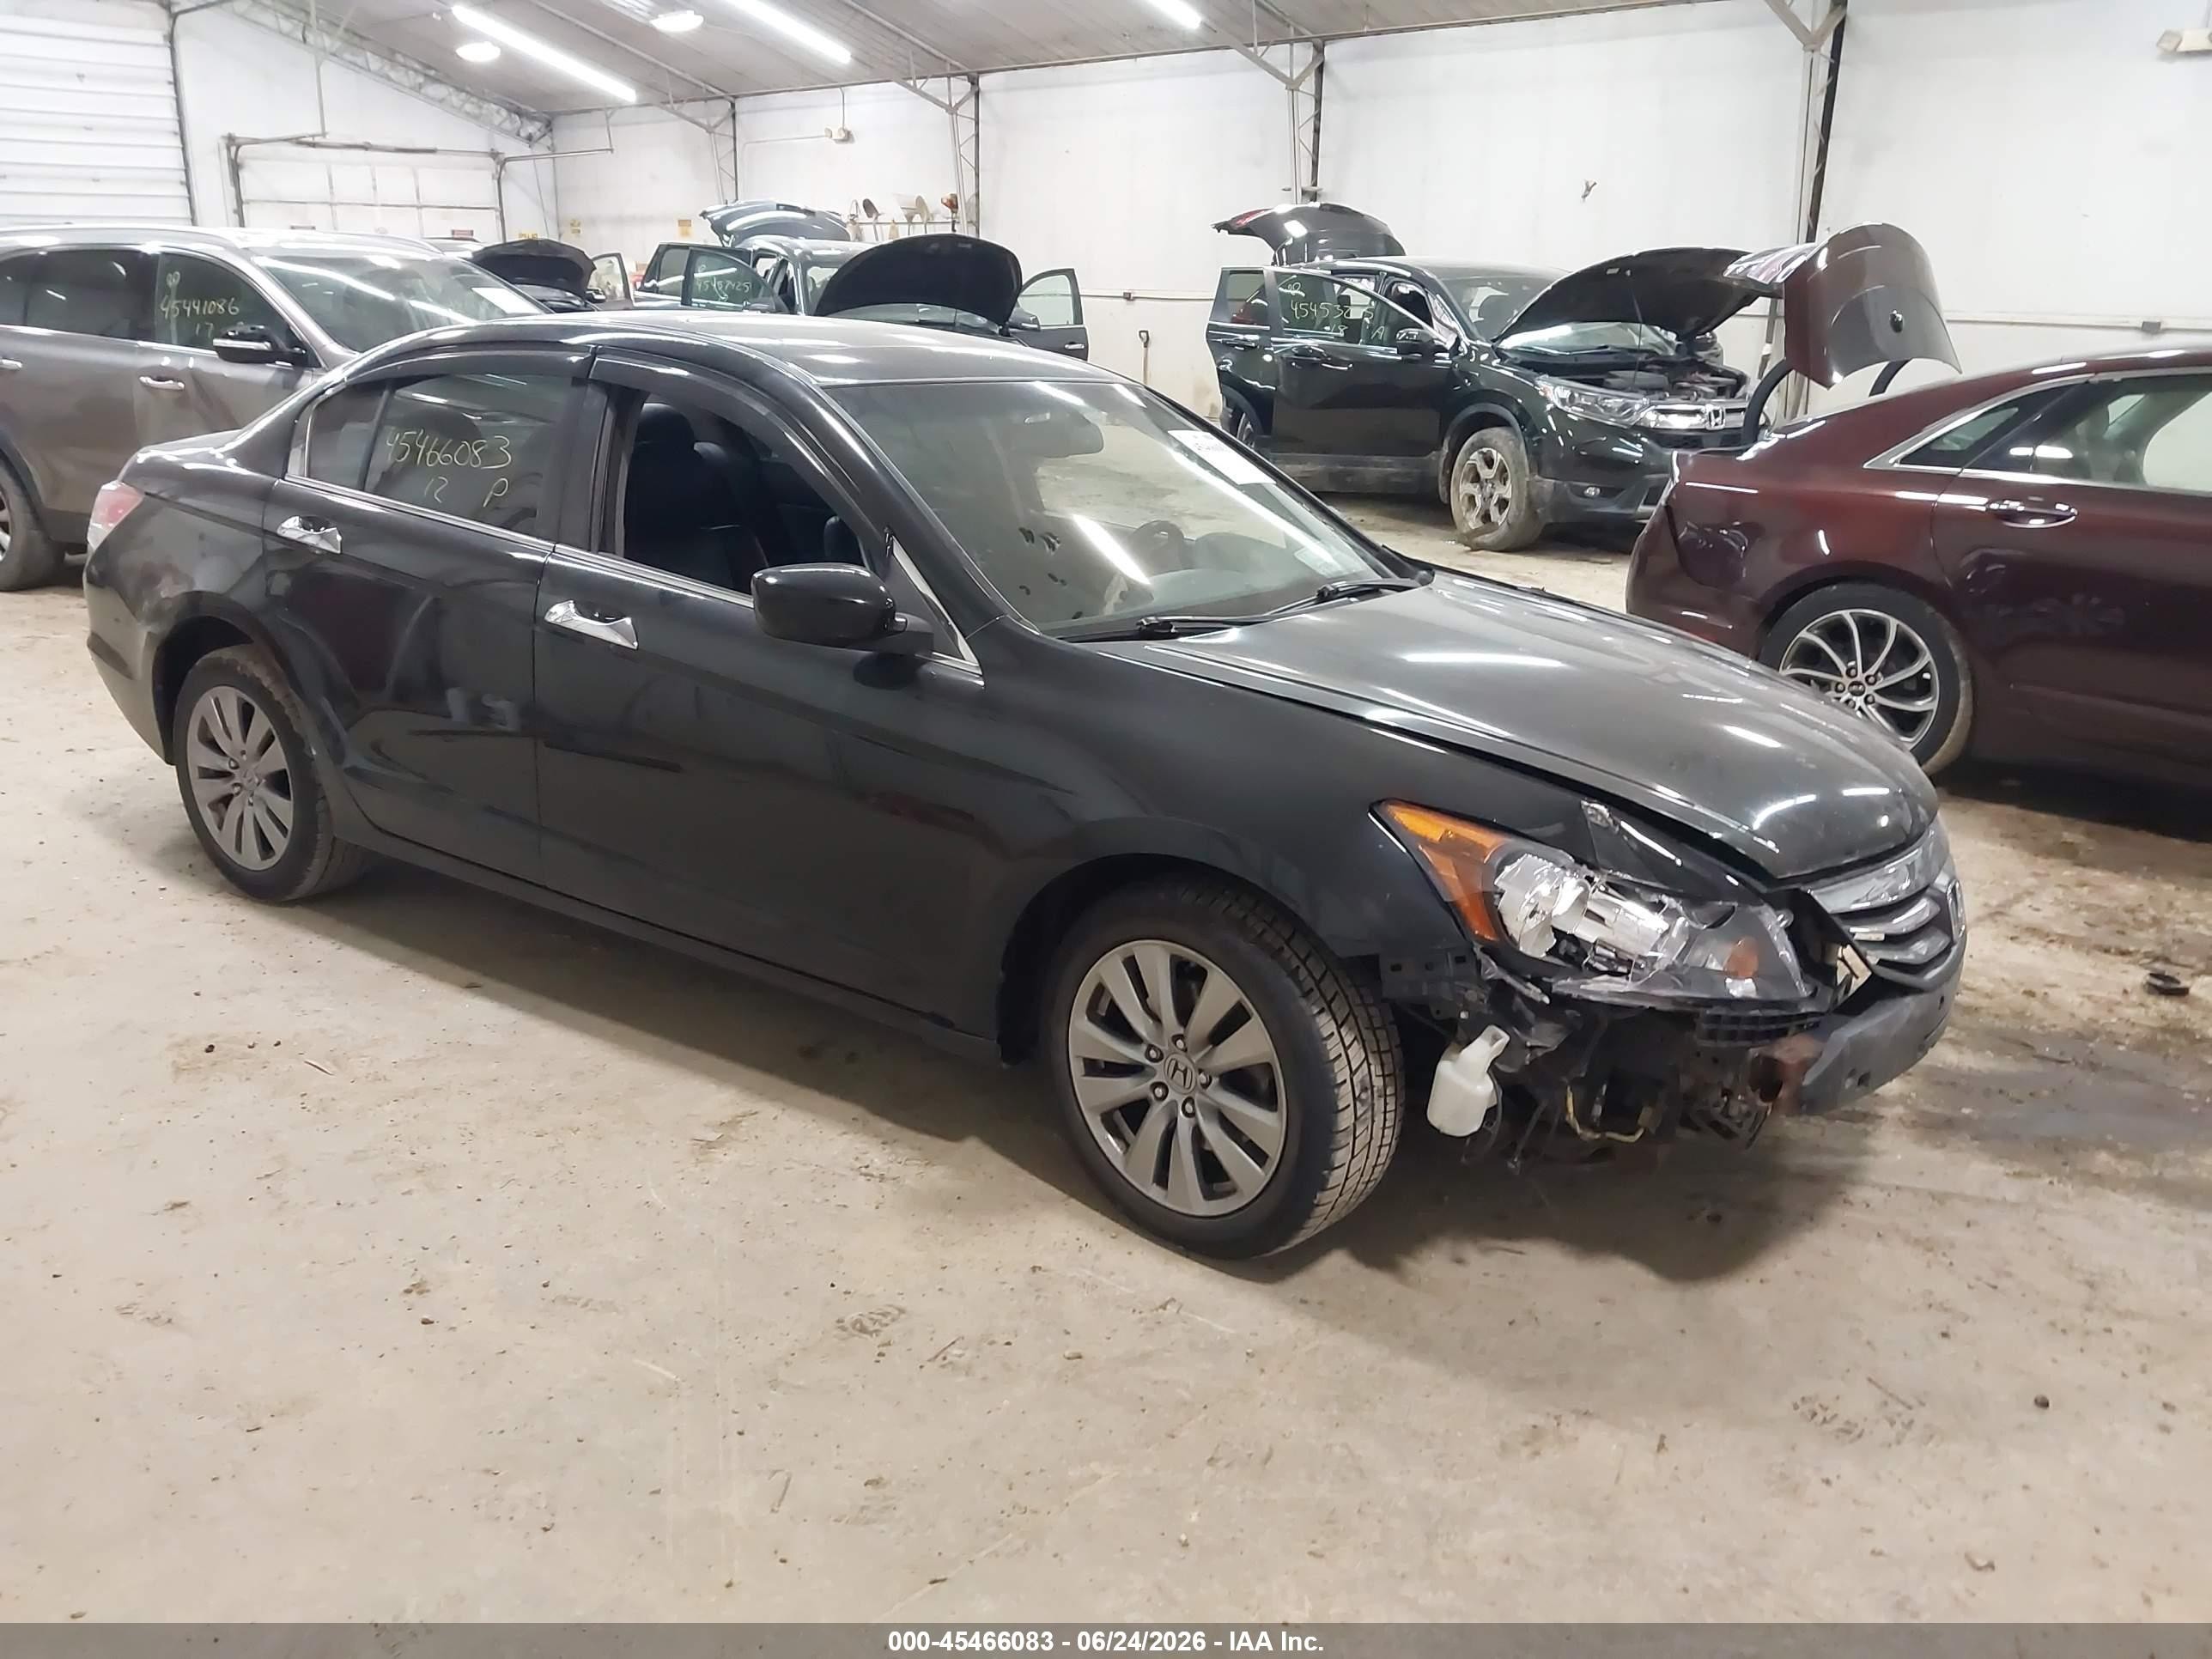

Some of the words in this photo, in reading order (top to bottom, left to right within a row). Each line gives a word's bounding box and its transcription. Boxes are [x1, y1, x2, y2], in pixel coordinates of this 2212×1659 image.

[160, 295, 240, 319] 45441086
[1370, 325, 1385, 340] A
[386, 429, 512, 470] 45466083
[424, 476, 448, 503] 12
[483, 477, 509, 507] P
